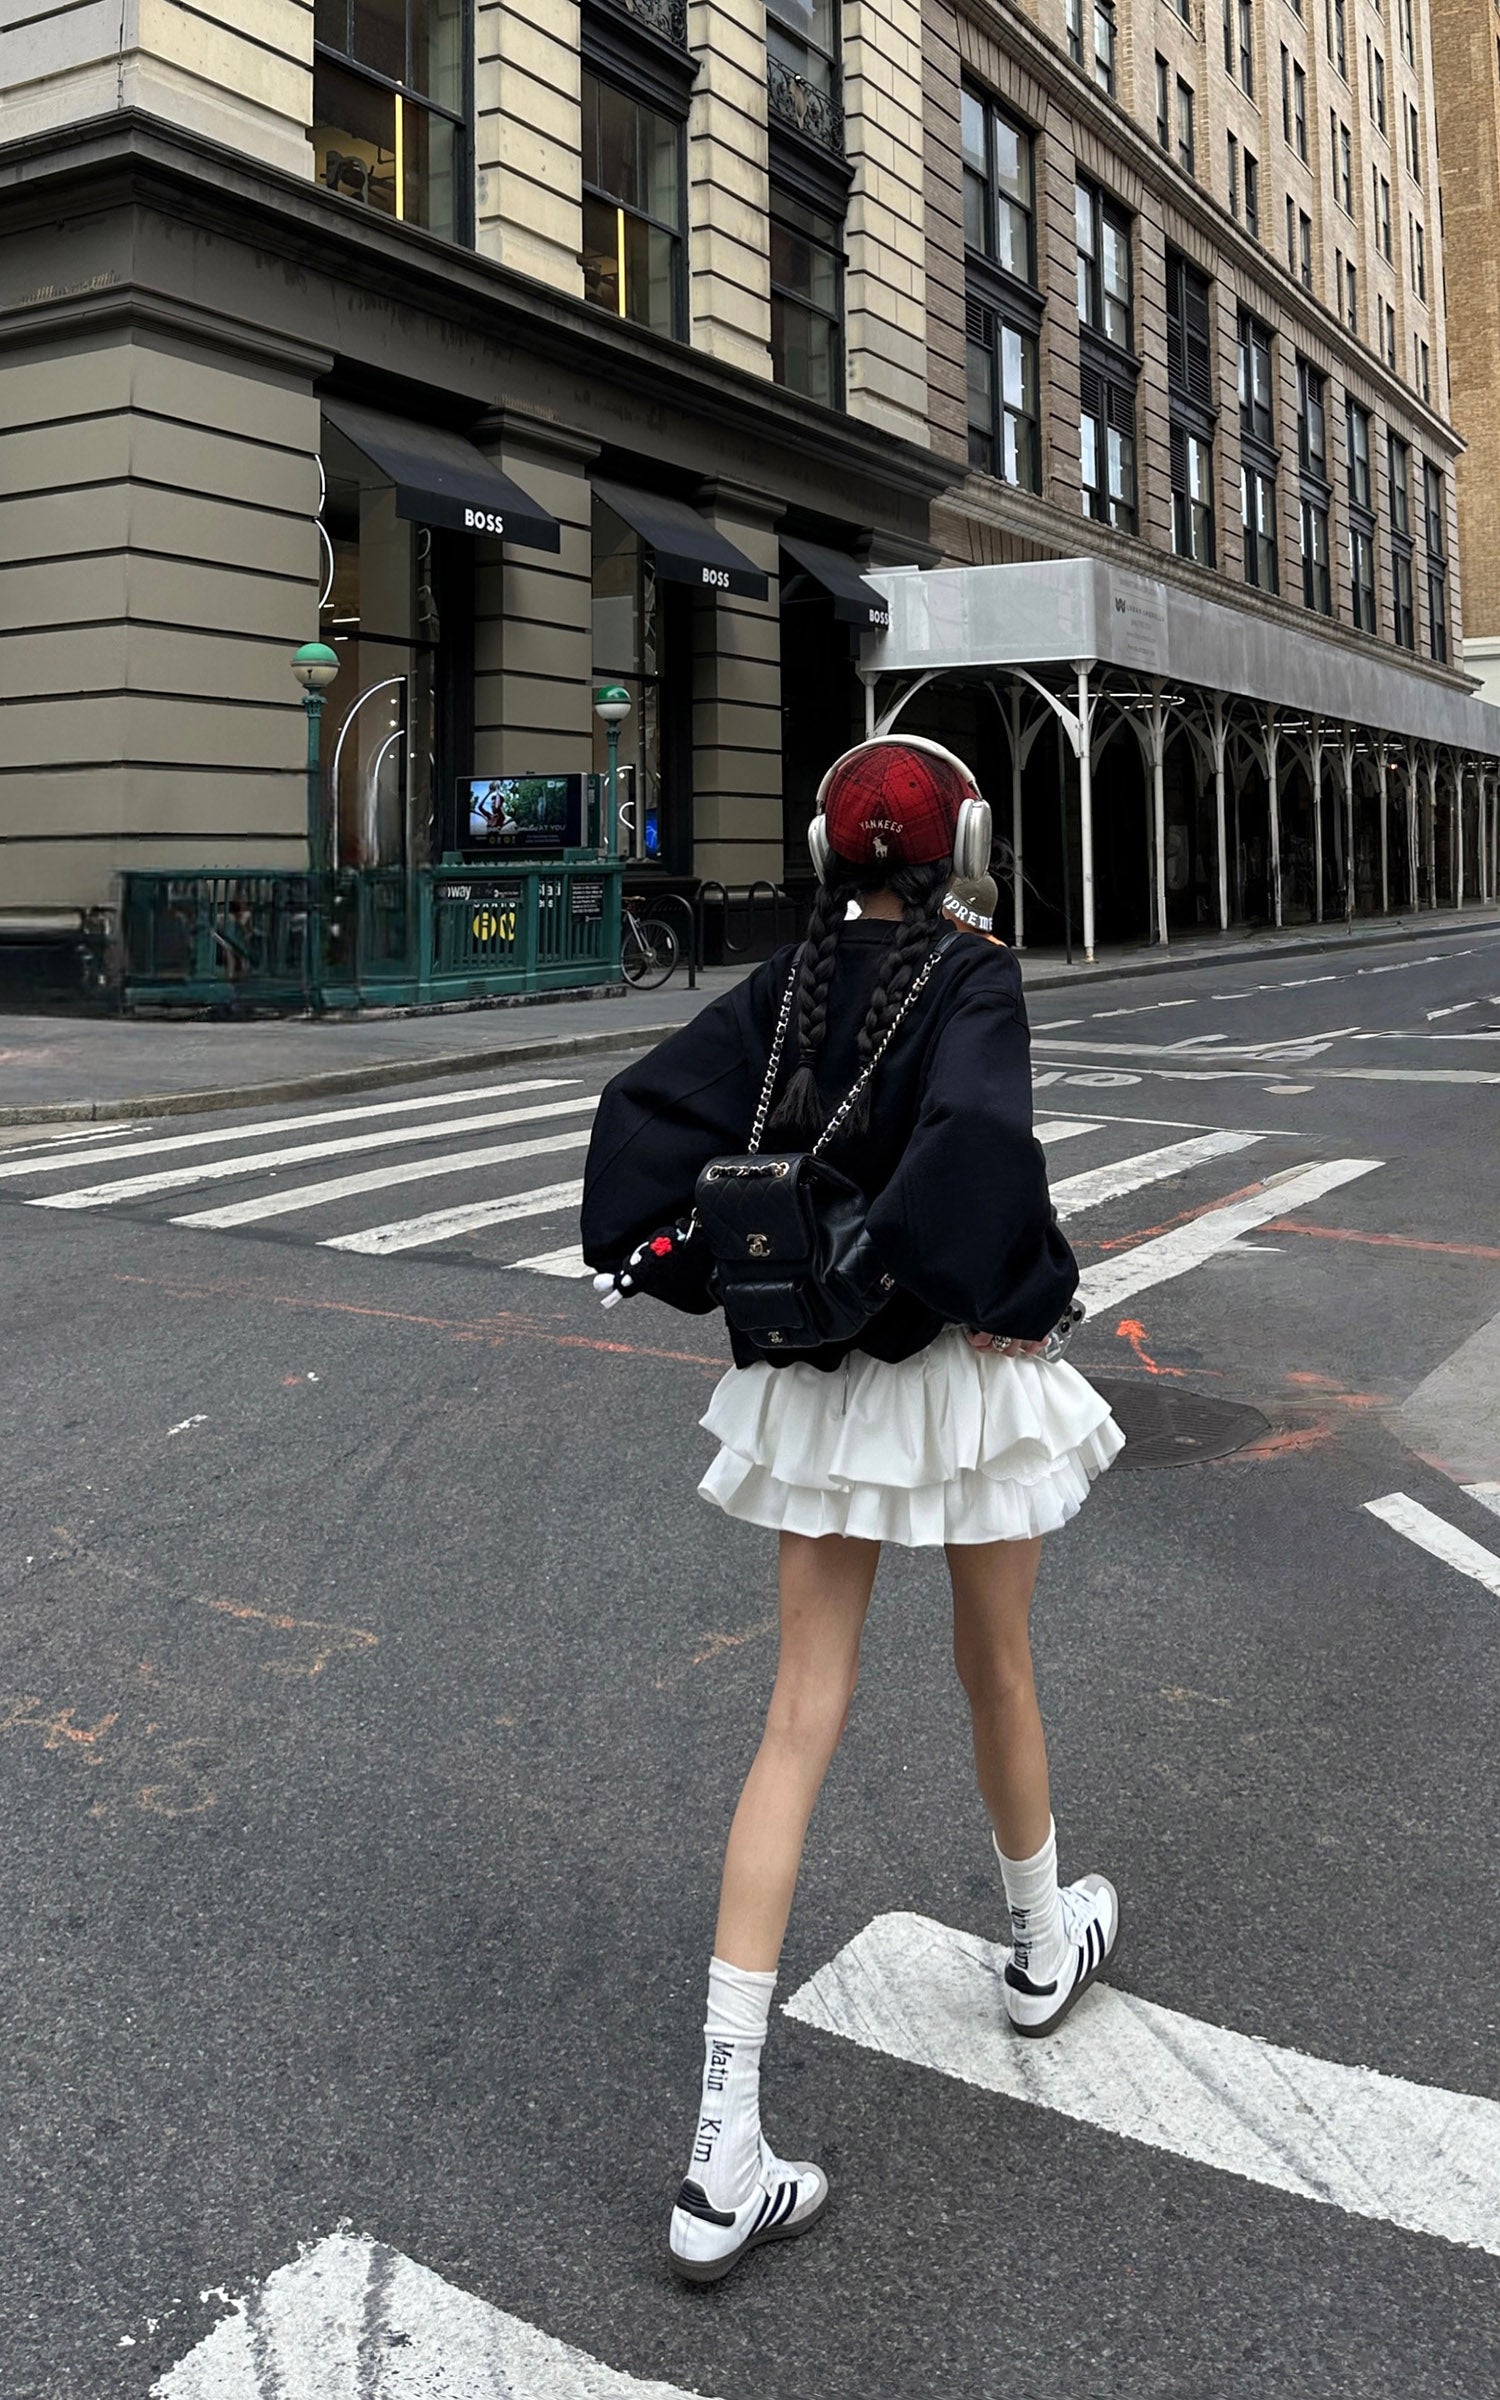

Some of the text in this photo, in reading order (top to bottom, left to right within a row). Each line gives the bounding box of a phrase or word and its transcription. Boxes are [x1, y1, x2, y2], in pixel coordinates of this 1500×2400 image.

[465, 508, 504, 534] BOSS
[702, 568, 730, 588] BOSS
[869, 609, 889, 625] BOSS
[859, 819, 904, 834] YANKEES
[693, 2039, 735, 2163] Matin Kim
